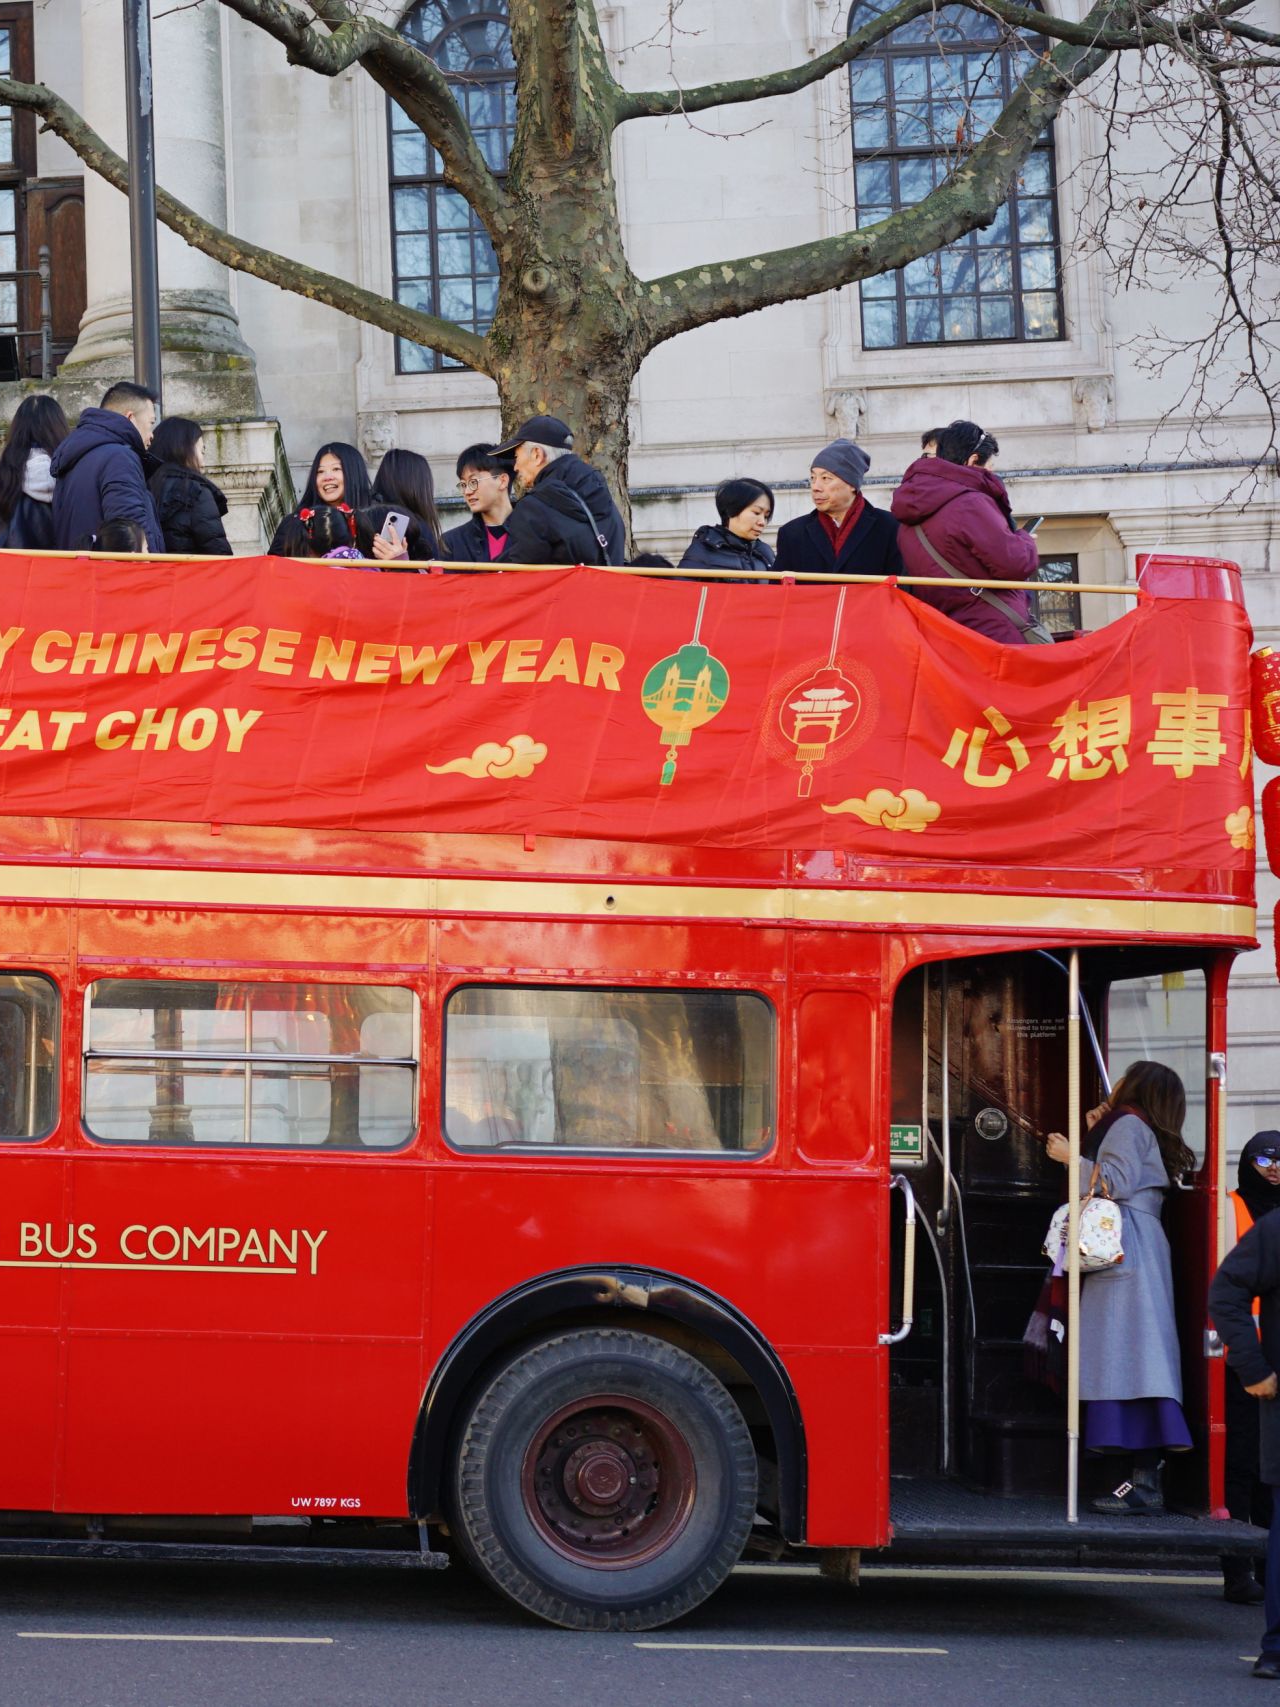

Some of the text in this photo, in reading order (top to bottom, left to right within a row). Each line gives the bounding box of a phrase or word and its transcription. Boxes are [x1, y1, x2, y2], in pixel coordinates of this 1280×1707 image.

[30, 626, 302, 676] CHINESE
[308, 635, 458, 685] NEW
[469, 637, 625, 692] YEAR
[94, 708, 264, 753] CHOY
[941, 686, 1252, 788] 心想事
[19, 1222, 98, 1259] BUS
[119, 1224, 328, 1275] COMPANY
[291, 1497, 361, 1508] UW 7897 KGS
